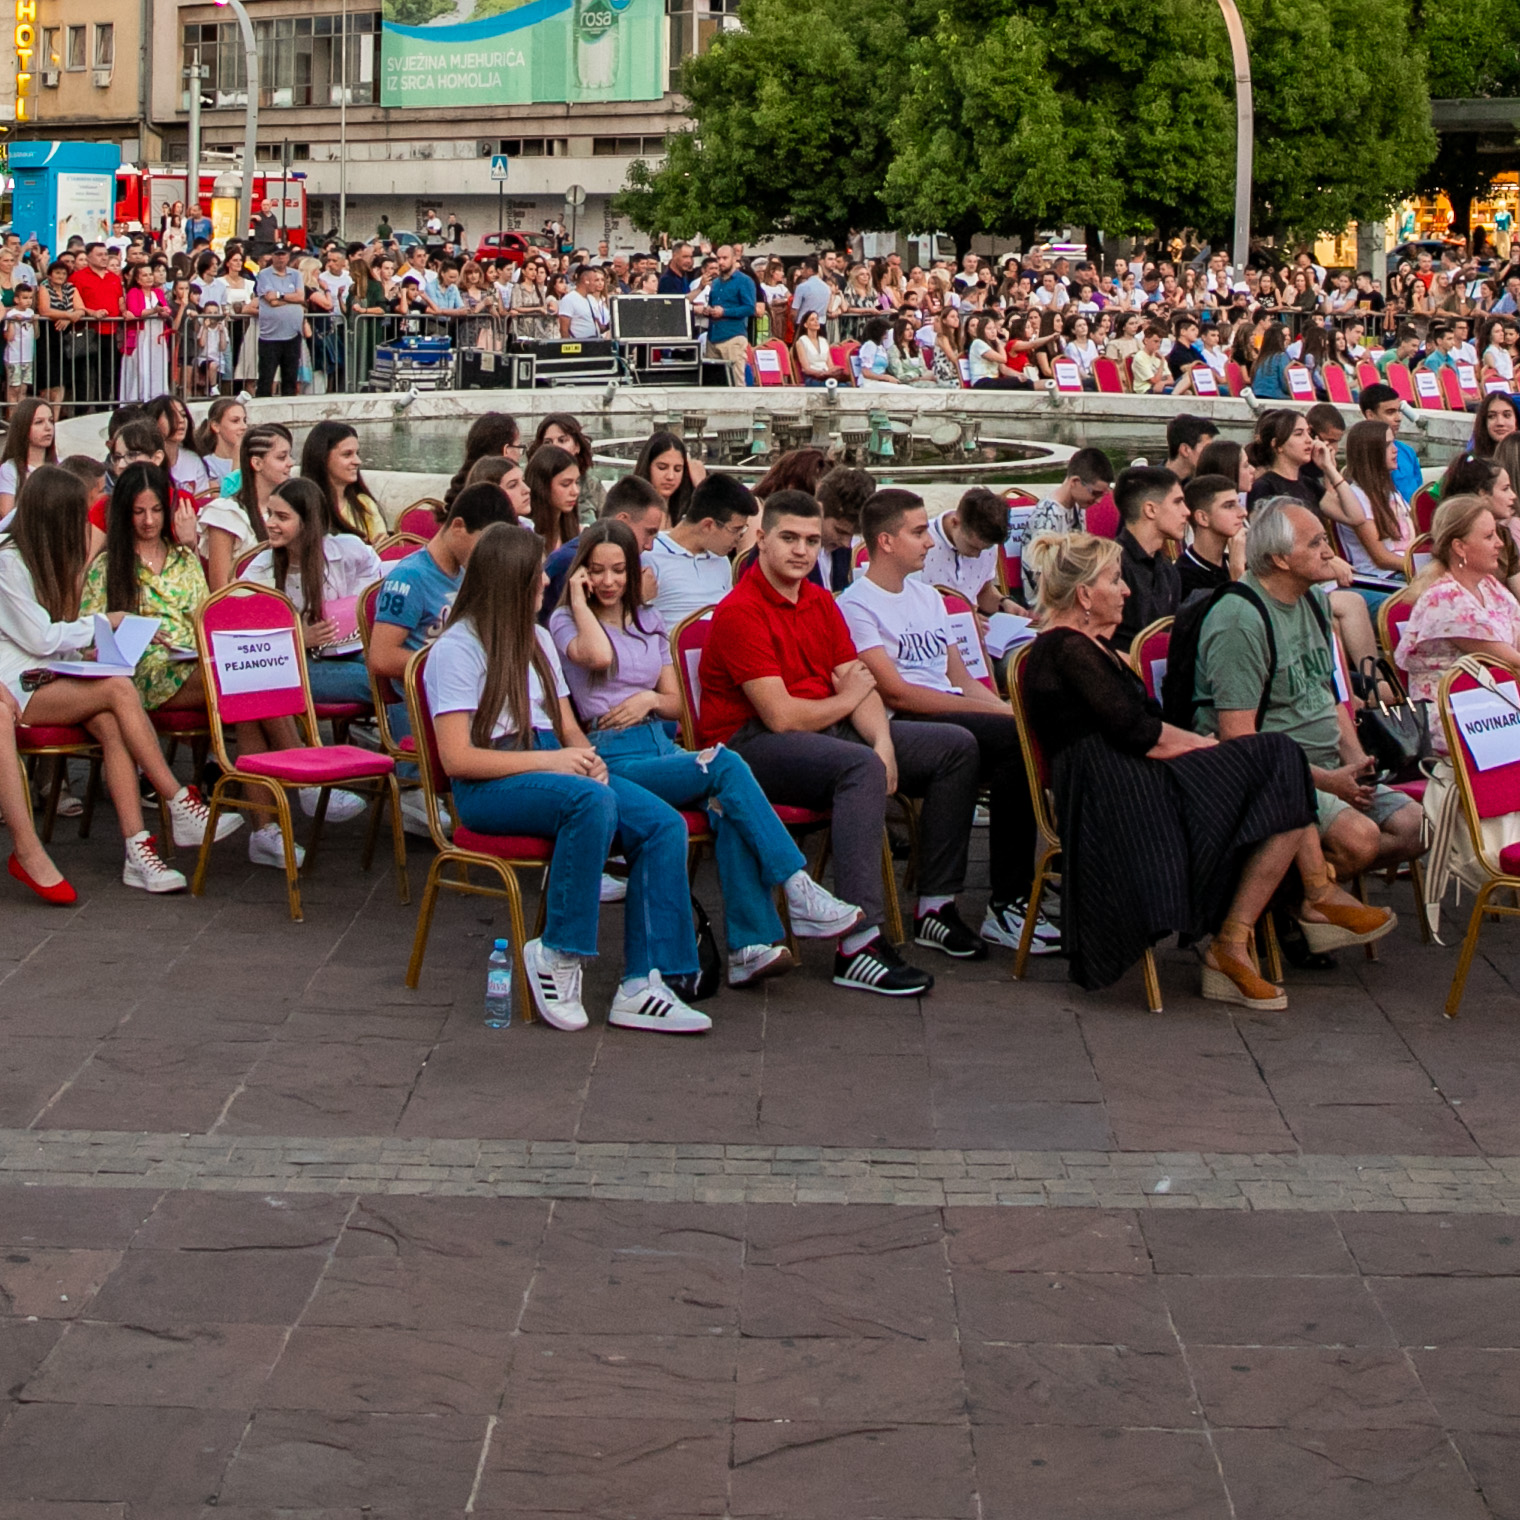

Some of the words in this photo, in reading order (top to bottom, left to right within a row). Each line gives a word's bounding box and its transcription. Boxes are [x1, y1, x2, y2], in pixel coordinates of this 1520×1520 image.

[581, 11, 611, 26] rosa
[15, 0, 36, 121] HOTEL
[387, 52, 447, 72] SVJEŽINA
[450, 48, 526, 69] MJEHURIĆA
[387, 76, 397, 90] IZ
[401, 74, 435, 90] SRCA
[438, 72, 502, 88] HOMOLJA
[383, 580, 411, 596] TEAM
